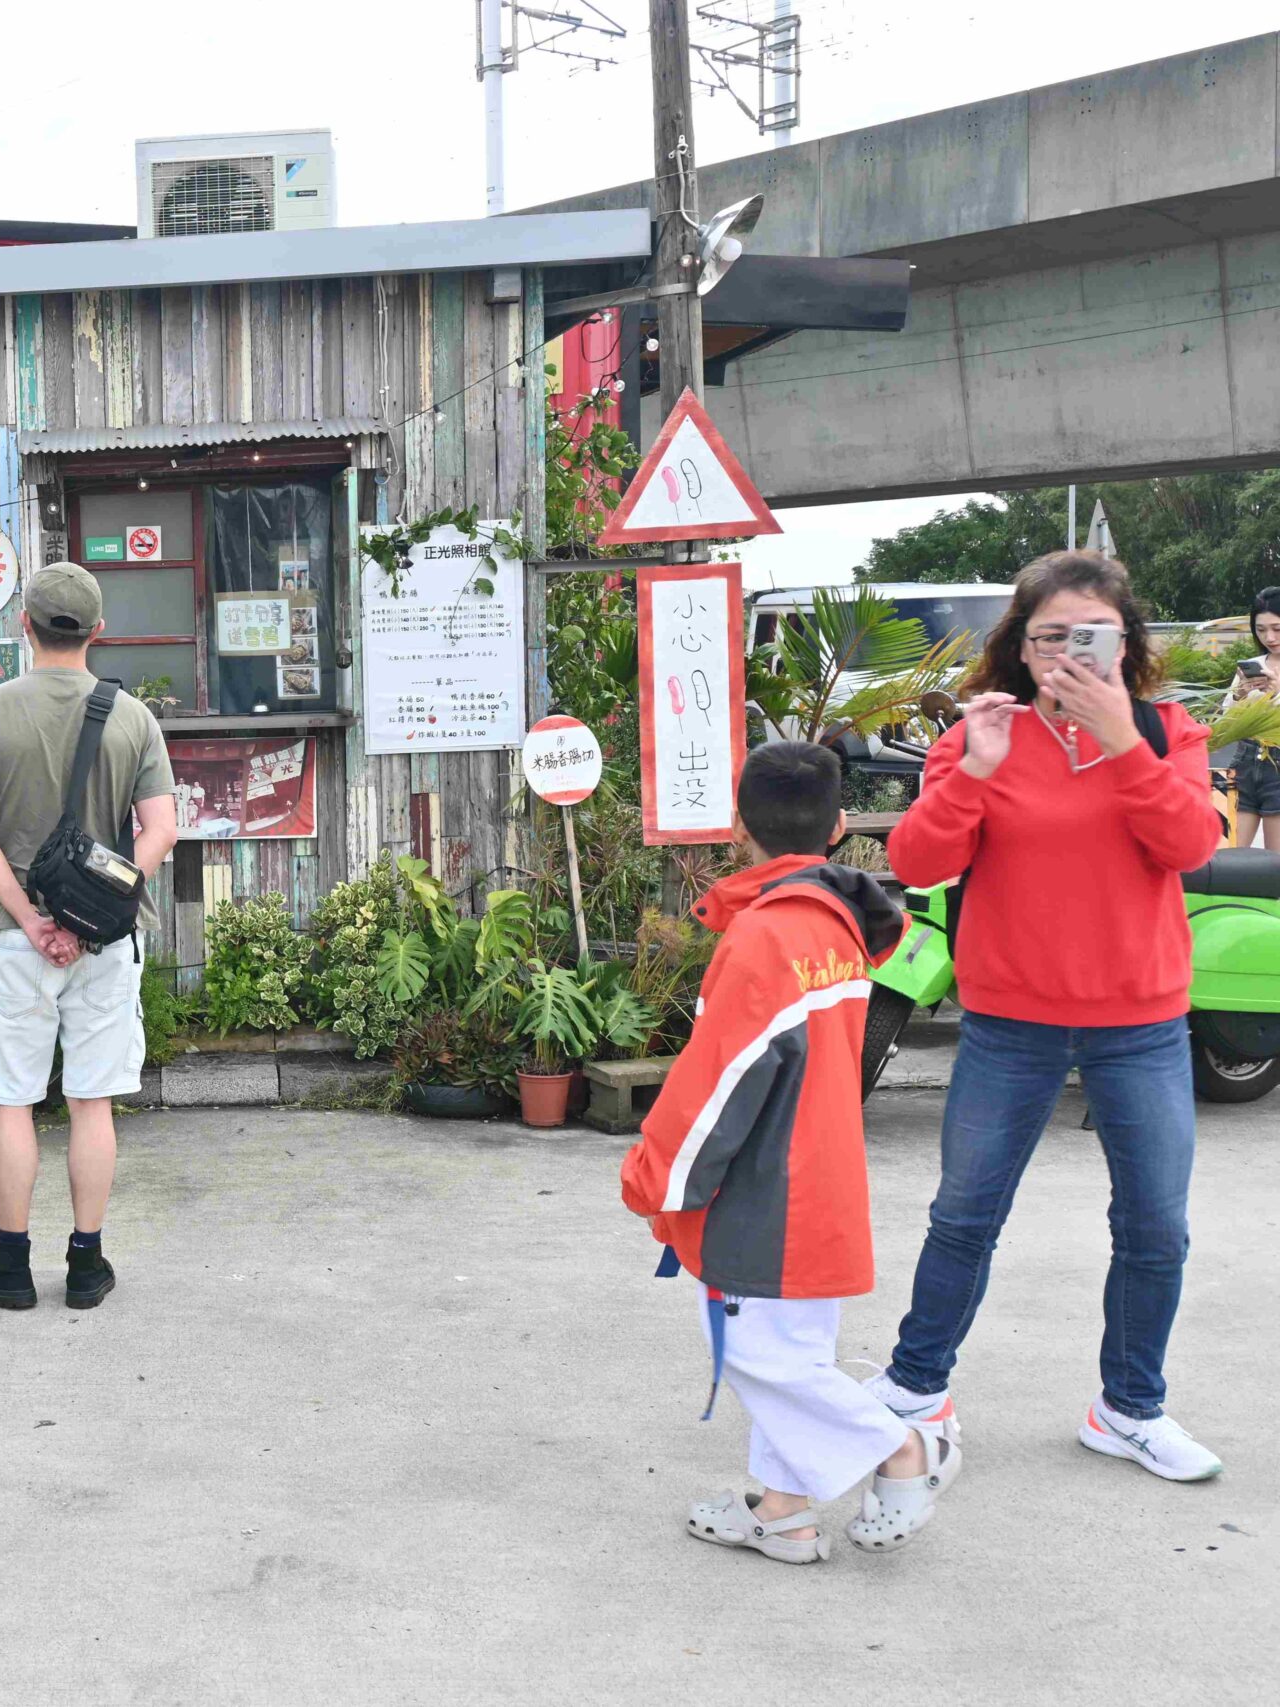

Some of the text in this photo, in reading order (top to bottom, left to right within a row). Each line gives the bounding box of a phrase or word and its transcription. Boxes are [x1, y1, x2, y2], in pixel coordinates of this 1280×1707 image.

[424, 544, 491, 559] 正光照相館
[380, 589, 418, 598] 鴨香腸
[672, 594, 712, 653] 小心
